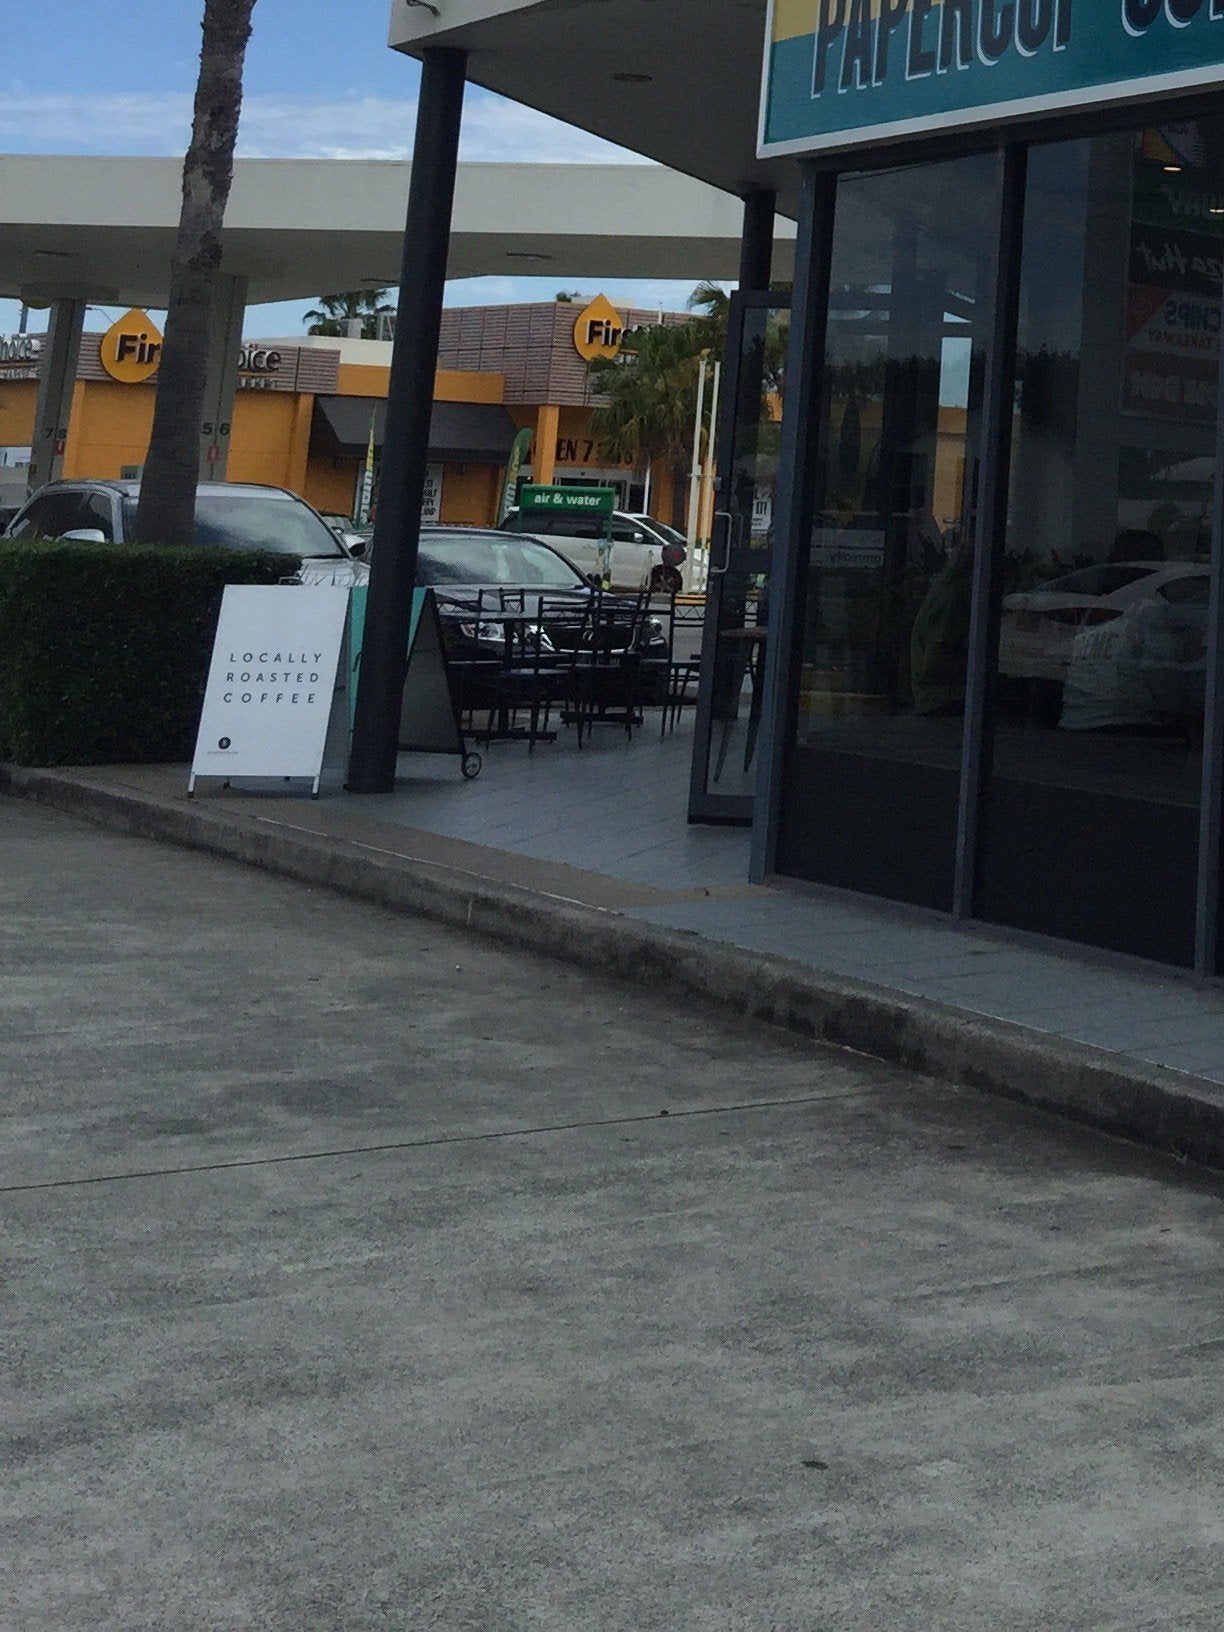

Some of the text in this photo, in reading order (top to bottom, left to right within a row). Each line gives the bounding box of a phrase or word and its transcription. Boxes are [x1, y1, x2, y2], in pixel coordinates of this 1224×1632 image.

[202, 423, 231, 436] 5 6
[583, 440, 594, 464] 7
[534, 492, 602, 507] air & water
[229, 652, 322, 663] LOCALLY
[226, 672, 319, 683] ROASTED
[223, 692, 316, 704] COFFEE
